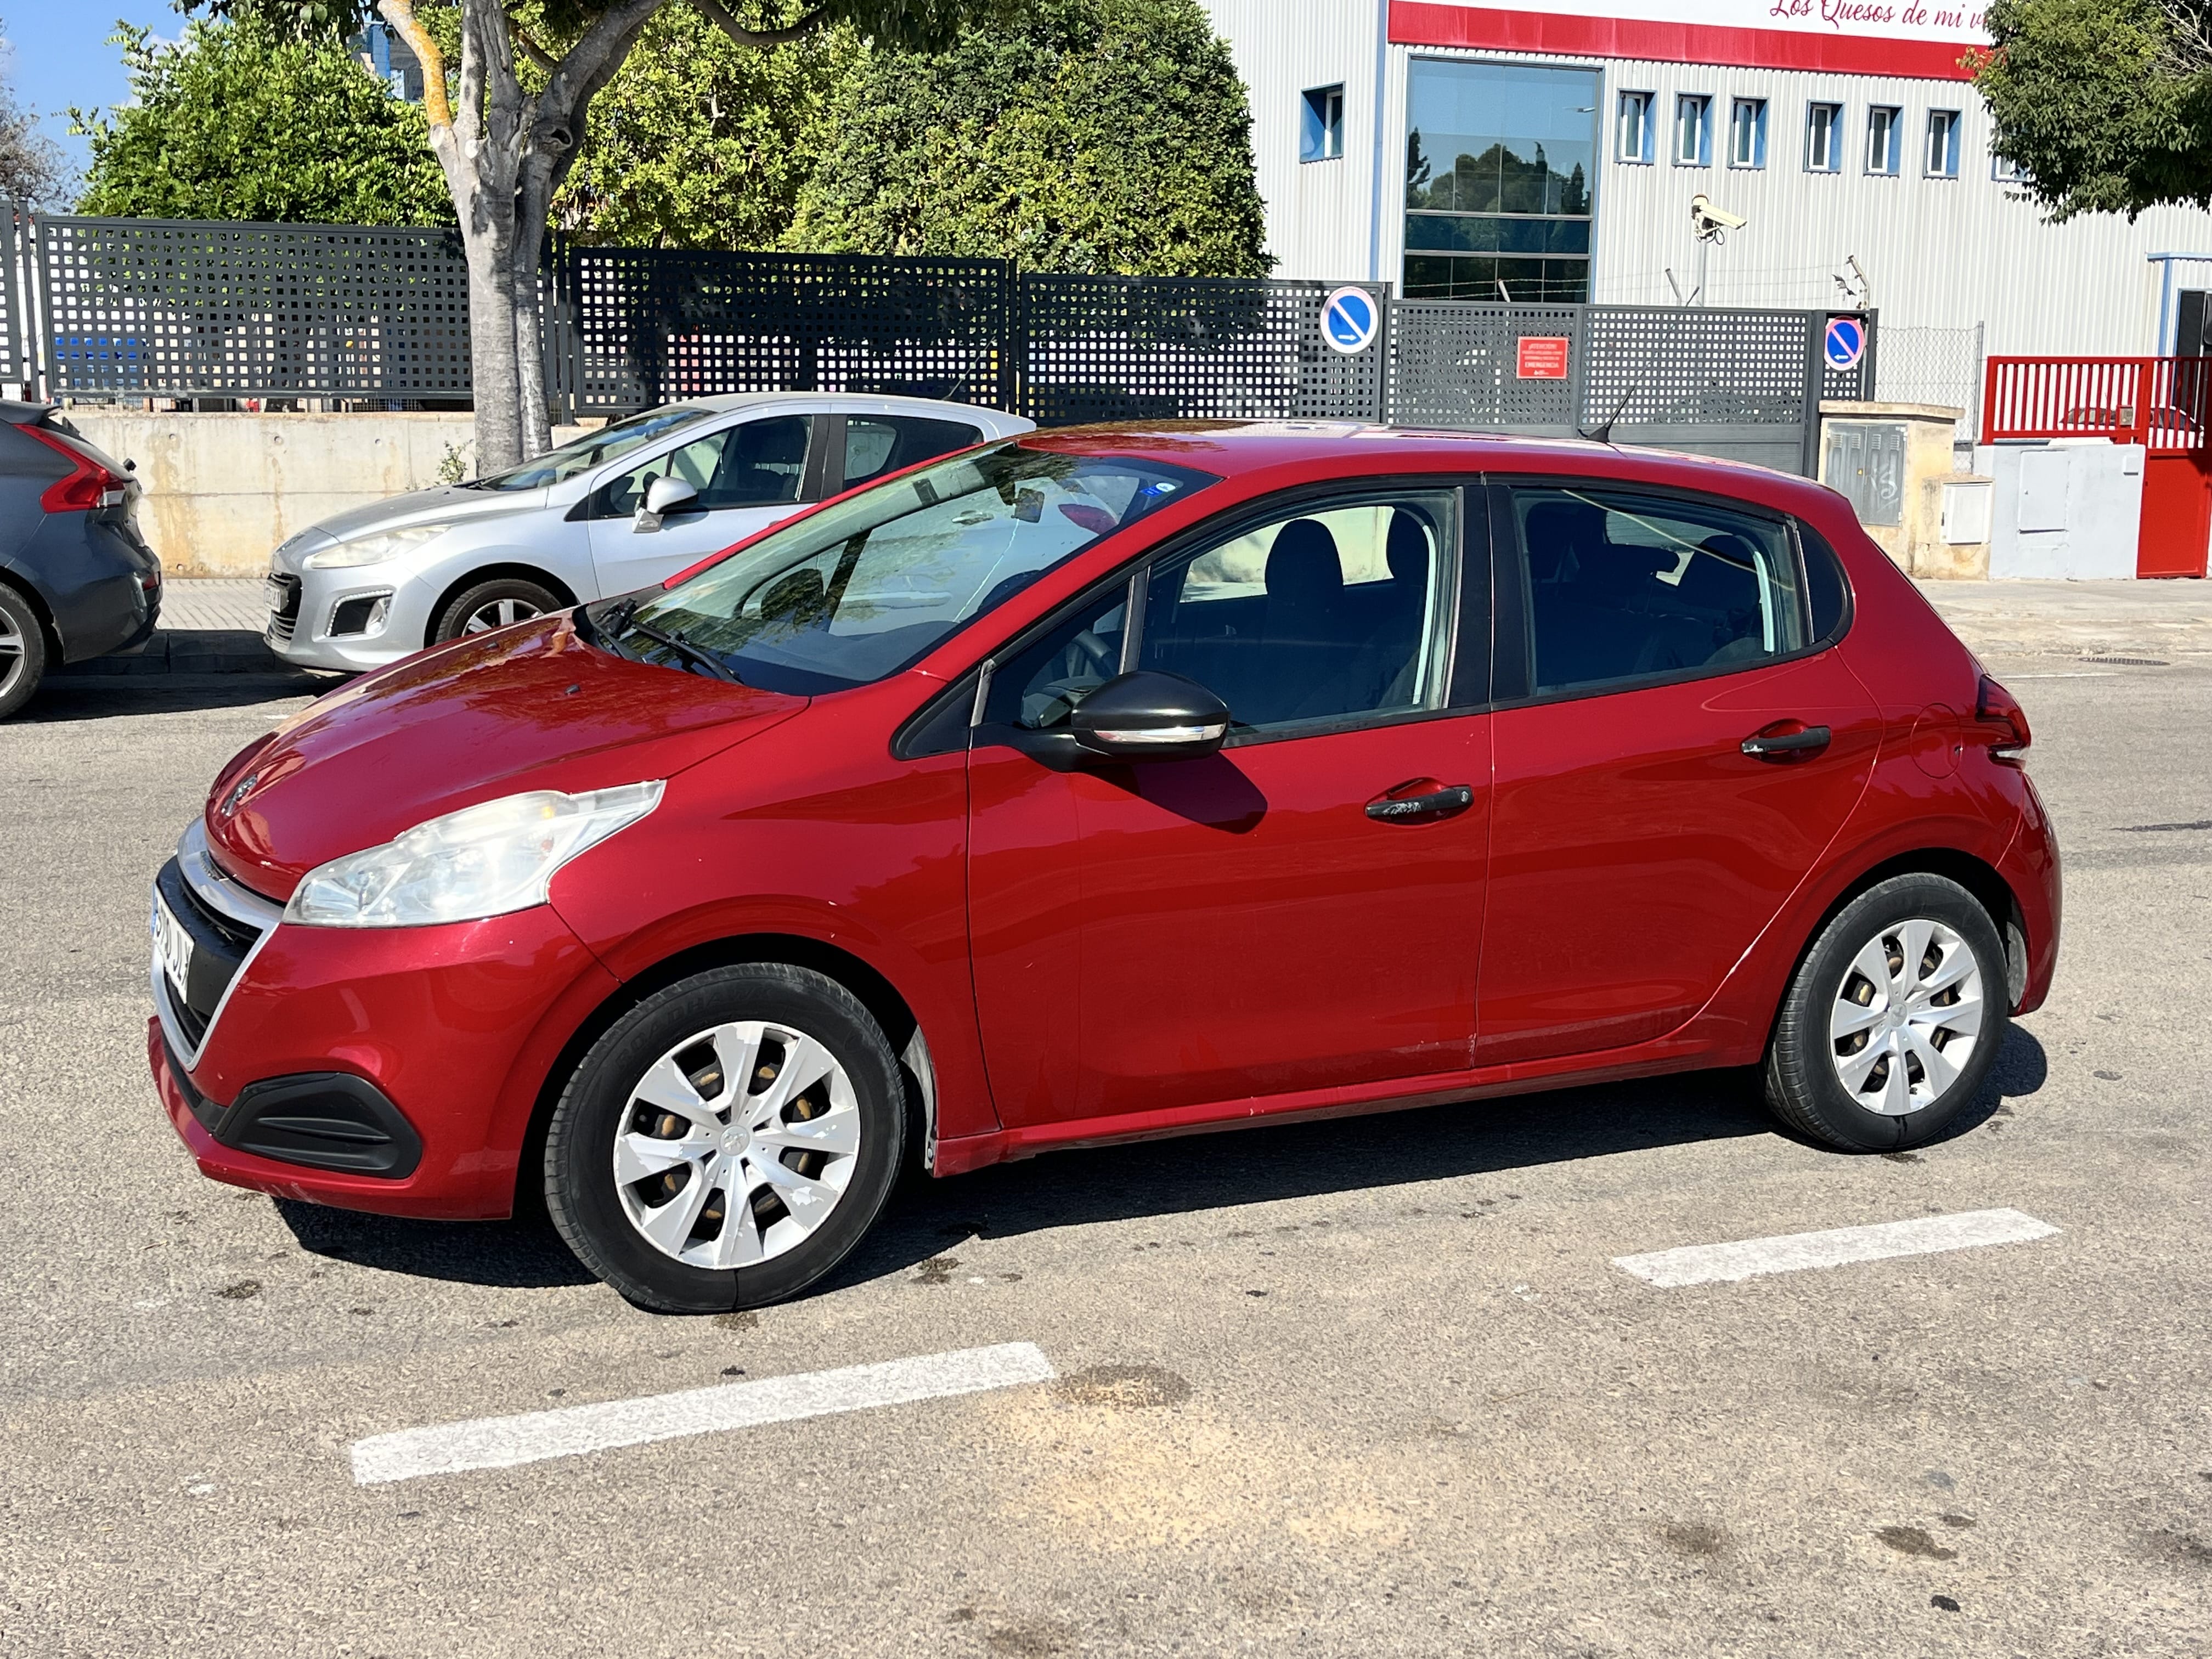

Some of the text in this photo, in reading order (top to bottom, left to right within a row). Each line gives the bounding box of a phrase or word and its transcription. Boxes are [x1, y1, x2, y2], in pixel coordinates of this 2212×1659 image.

[1770, 0, 1814, 19] Los
[1821, 0, 1896, 30] Quesos
[1902, 0, 1927, 25] de
[1934, 4, 1965, 27] mi
